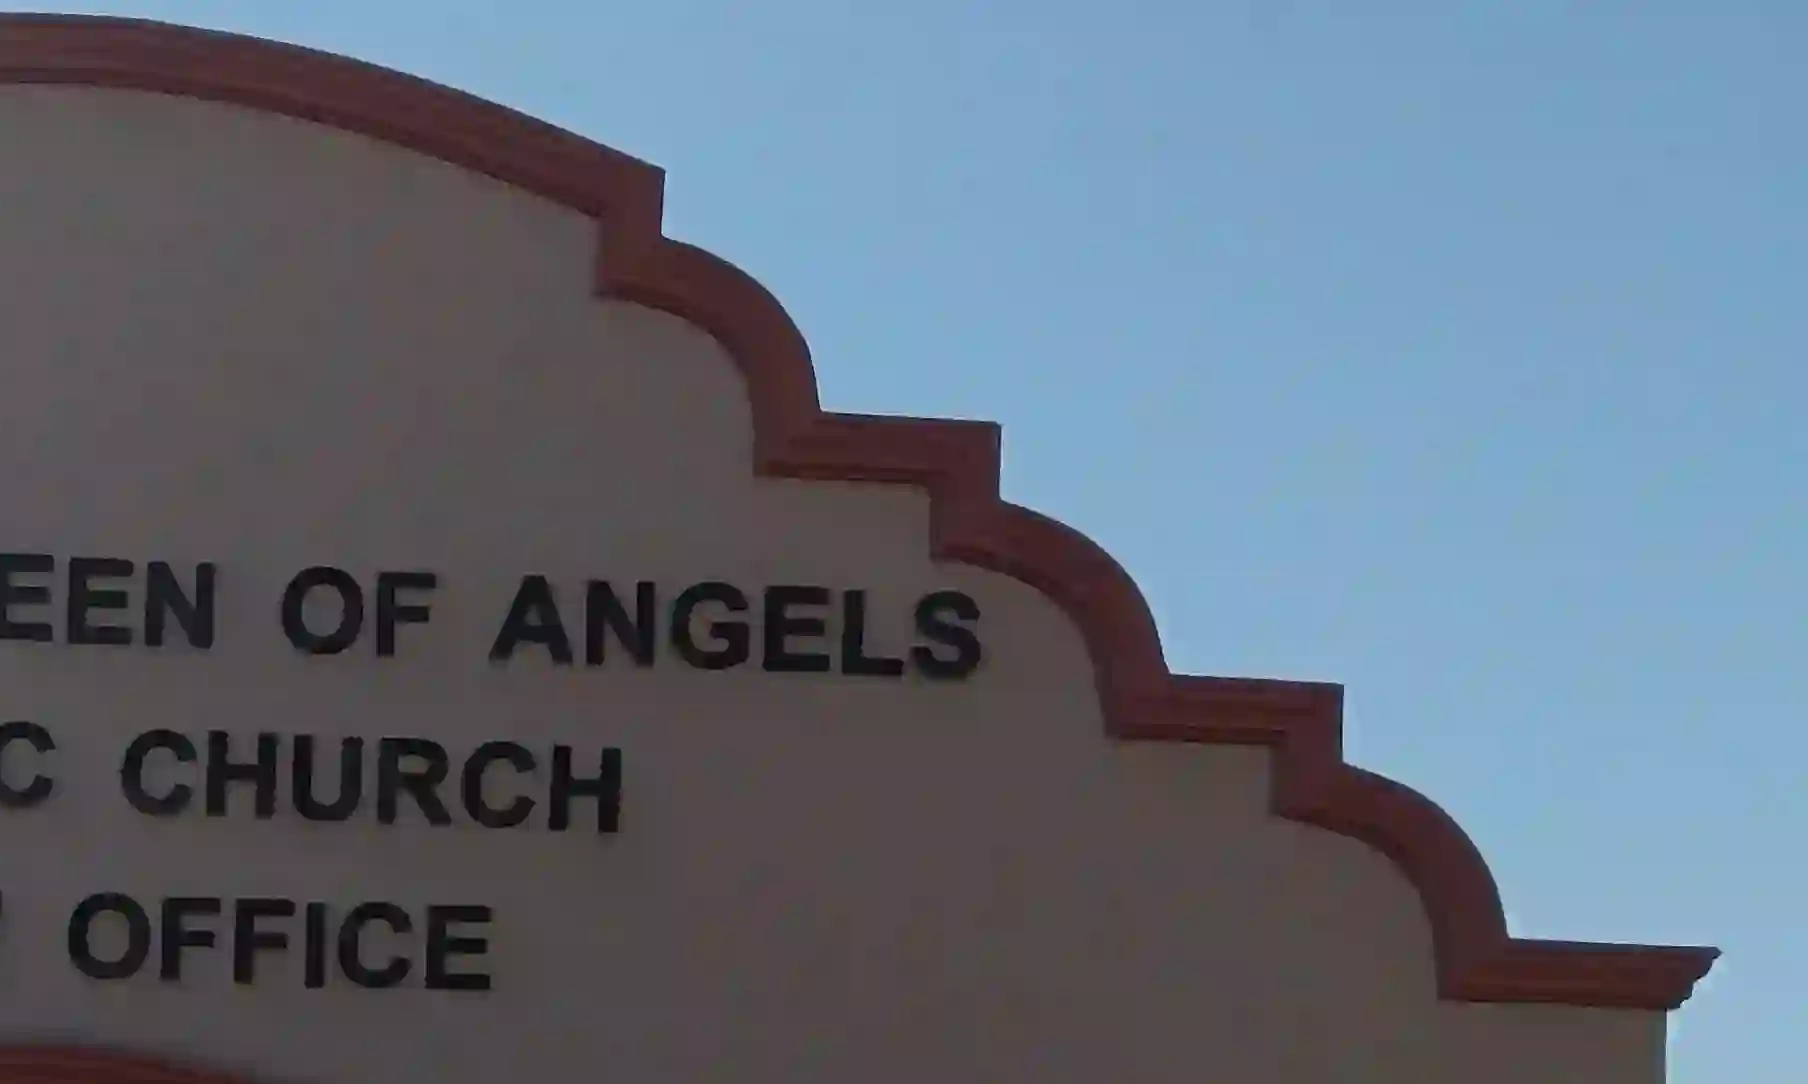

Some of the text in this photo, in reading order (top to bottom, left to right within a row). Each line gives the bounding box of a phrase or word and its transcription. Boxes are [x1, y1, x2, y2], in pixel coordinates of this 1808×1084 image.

[280, 565, 438, 659] OF
[488, 574, 983, 680] ANGELS
[119, 729, 623, 834] CHURCH
[66, 892, 493, 991] OFFICE
